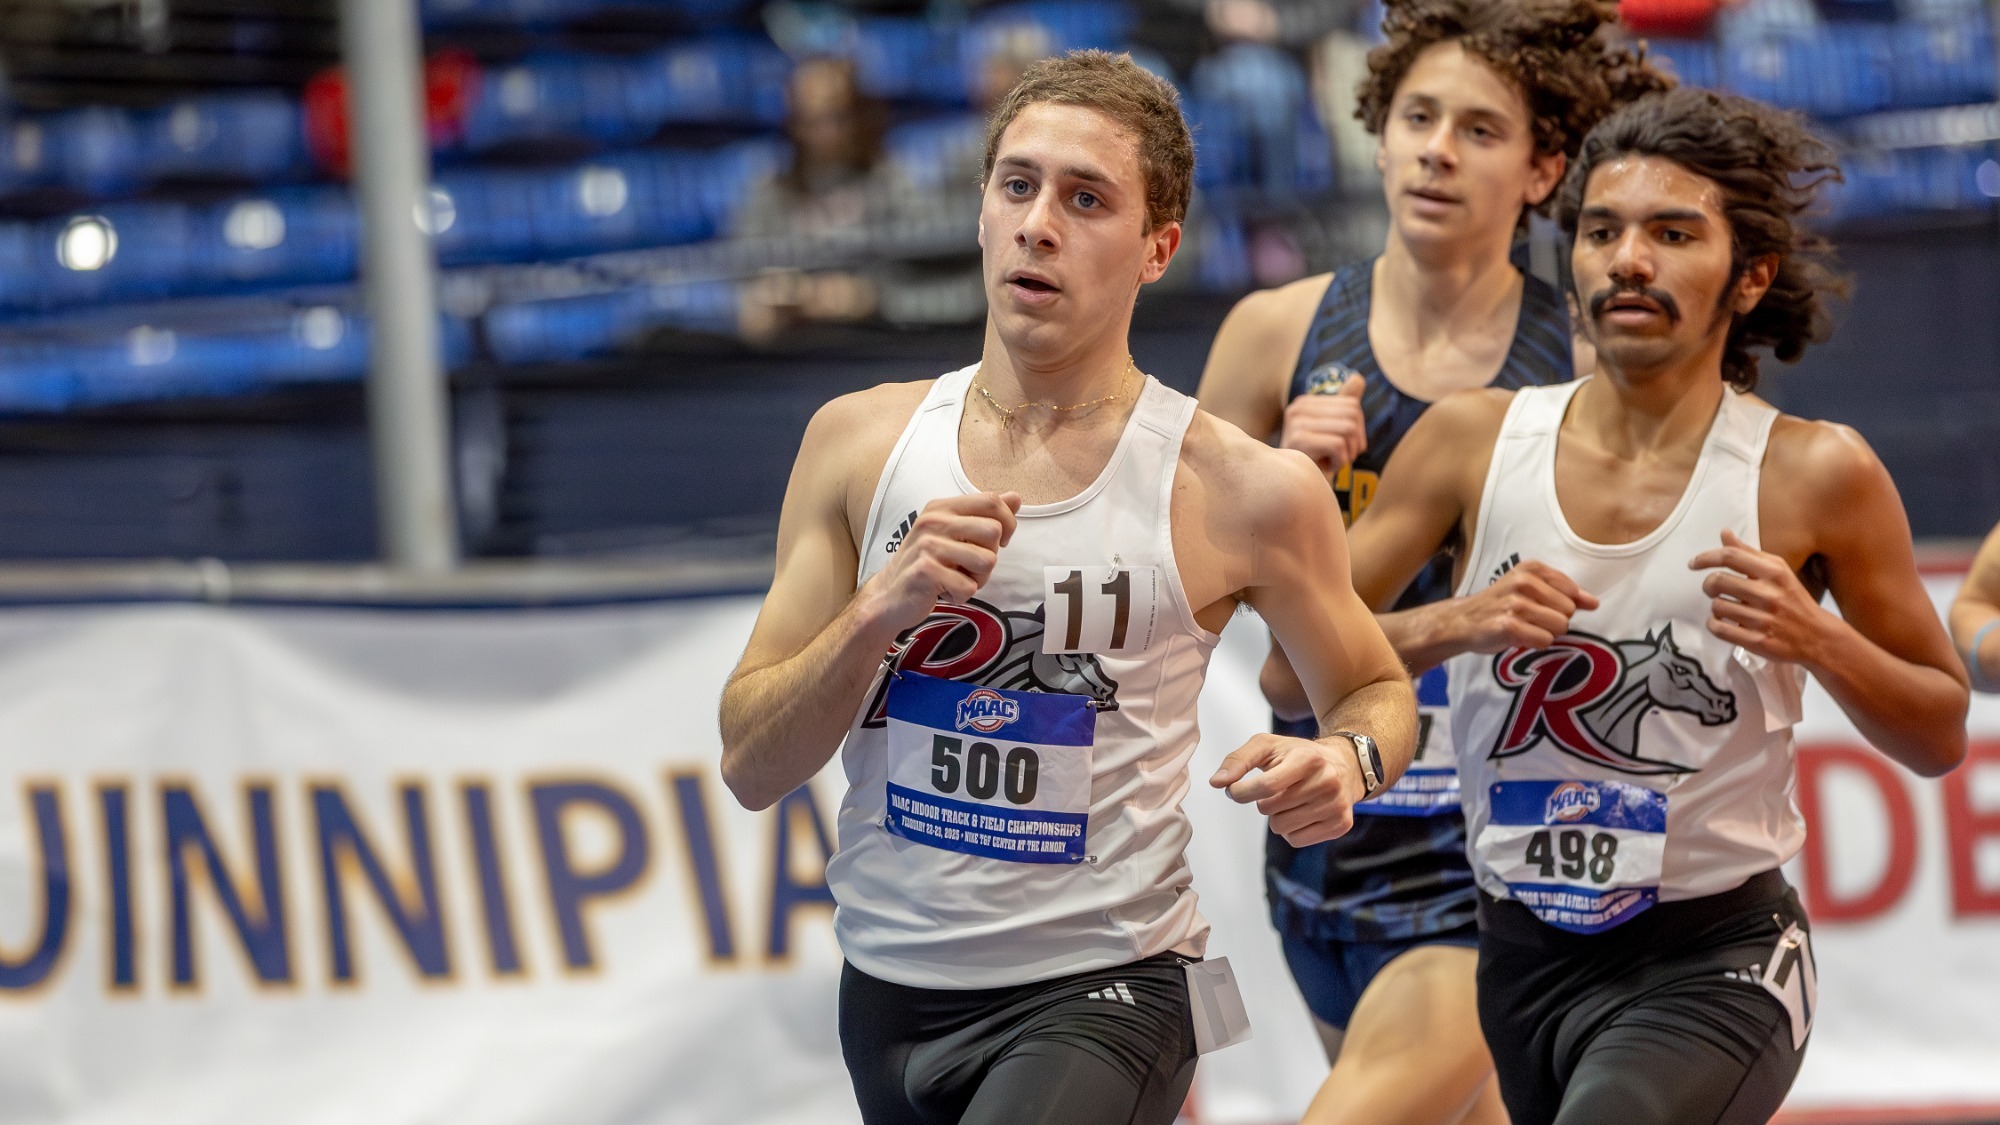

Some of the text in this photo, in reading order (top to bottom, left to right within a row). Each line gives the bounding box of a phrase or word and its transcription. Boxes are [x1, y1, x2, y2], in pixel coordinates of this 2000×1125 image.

[1054, 571, 1130, 650] 11
[956, 698, 1018, 728] MAAC
[931, 733, 1039, 805] 500
[891, 793, 1082, 837] MAAC INDOOR TRACK & FIELD CHAMPIONSHIPS
[1546, 789, 1598, 822] MAAC
[944, 827, 960, 841] 2025
[964, 831, 979, 844] NIKE
[992, 836, 1016, 850] CENTER
[1017, 840, 1025, 852] AT
[1027, 840, 1040, 852] THE
[1040, 841, 1067, 853] ARMORY
[1525, 829, 1618, 884] 498
